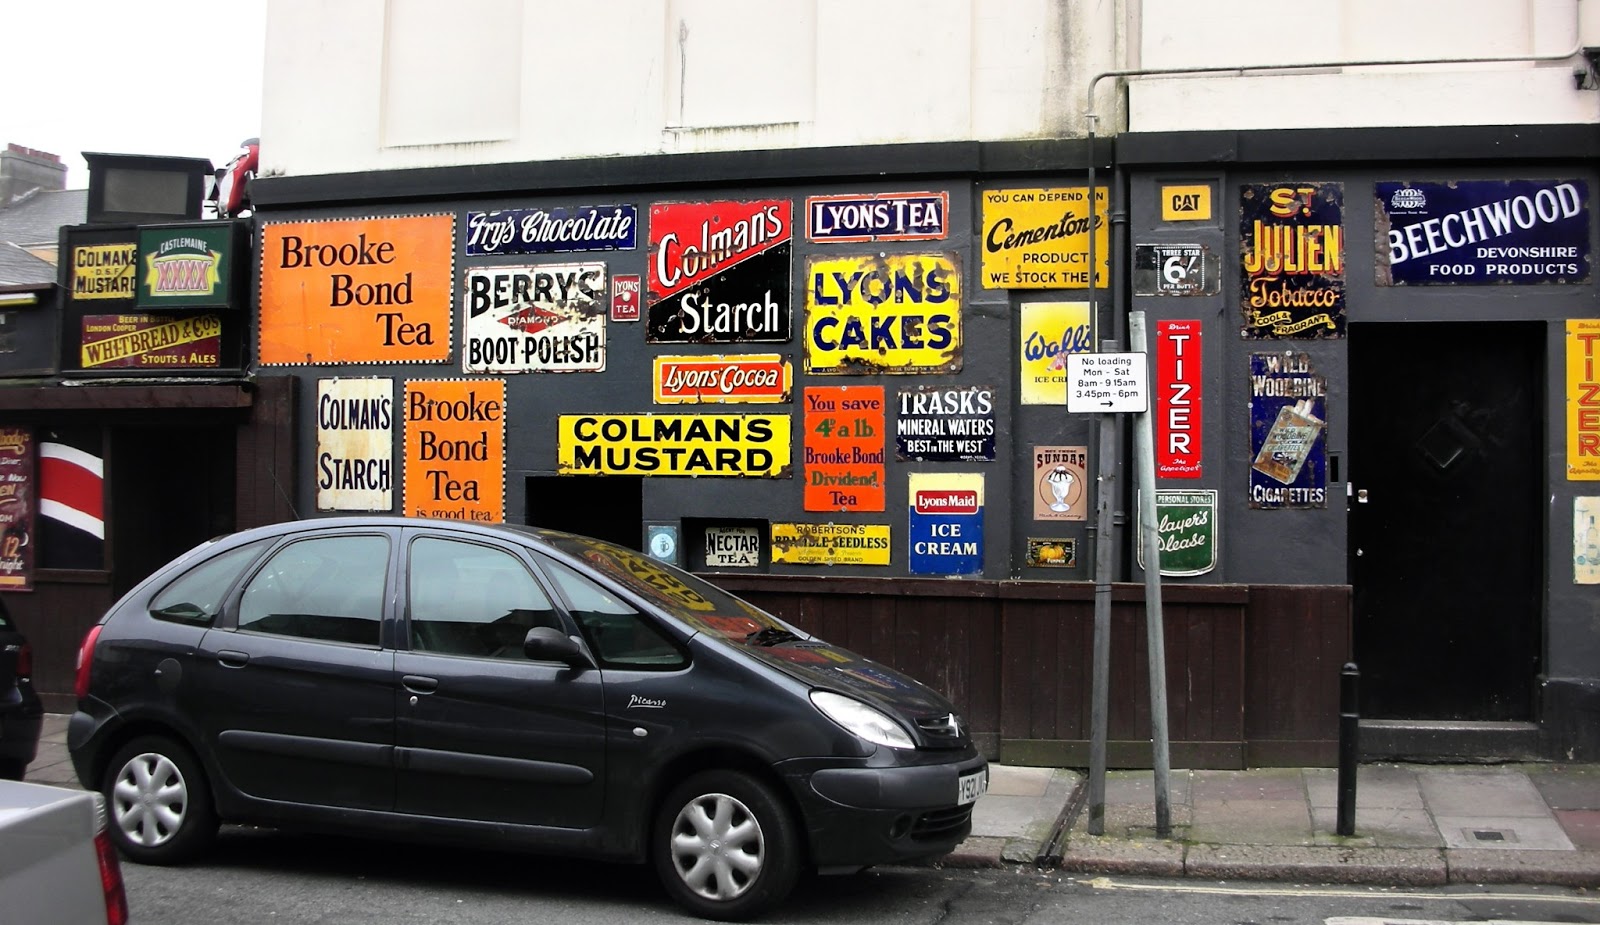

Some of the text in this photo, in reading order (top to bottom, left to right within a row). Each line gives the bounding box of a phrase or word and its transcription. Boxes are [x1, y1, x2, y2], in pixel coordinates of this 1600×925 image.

[988, 194, 1008, 204] YOU
[1012, 194, 1034, 202] CAN
[1038, 192, 1082, 202] DEPEND
[1172, 194, 1200, 212] CAT
[815, 200, 940, 235] LYONS' TEA
[1388, 184, 1580, 264] BEECHWOOD
[468, 208, 632, 252] Fry's Chocolate
[986, 211, 1102, 253] Cementone
[160, 238, 207, 254] CASTLEMAINE
[280, 233, 396, 268] Brooke
[656, 205, 782, 288] Colman's
[1245, 220, 1344, 275] JULIEN
[1476, 247, 1578, 258] DEVONSHIRE
[1023, 252, 1096, 264] PRODUCT
[154, 260, 212, 291] XXXX
[990, 272, 1010, 283] WE
[1016, 272, 1056, 283] STOCK
[1430, 264, 1578, 276] FOOD PRODUCTS
[330, 272, 414, 306] Bond
[1251, 278, 1340, 308] Tobacco
[616, 304, 636, 314] TEA
[679, 289, 778, 334] Starch
[112, 323, 136, 332] COOPER
[376, 312, 434, 346] Tea
[508, 316, 558, 326] DIAMOND
[1256, 314, 1281, 326] COOL
[1276, 316, 1326, 334] FRAGRANT
[813, 314, 952, 352] CAKES
[86, 324, 180, 364] WHITBREAD
[182, 321, 190, 338] &
[470, 336, 598, 364] BOOT POLISH
[142, 354, 178, 364] STOUTS
[190, 352, 216, 364] ALES
[1082, 357, 1132, 366] No loading
[1266, 356, 1308, 374] WILD
[664, 365, 778, 394] Lyons' Cocoa
[1114, 368, 1130, 376] Sat
[1078, 379, 1098, 388] 8am
[807, 394, 880, 412] You save
[898, 390, 992, 415] TRASK'S
[1076, 390, 1110, 398] 3.45pm
[1118, 390, 1139, 398] 6pm
[1169, 334, 1192, 454] TIZER
[1577, 333, 1600, 457] TIZER
[320, 394, 390, 430] COLMAN'S
[409, 390, 500, 422] Brooke
[574, 418, 773, 442] COLMAN'S
[838, 424, 850, 438] a
[854, 418, 876, 438] lb.
[898, 418, 994, 436] MINERAL WATERS
[420, 430, 488, 461] Bond
[937, 440, 955, 453] THE
[574, 446, 773, 472] MUSTARD
[806, 446, 884, 464] Brooke Bond
[1037, 454, 1084, 470] SUNDAE
[320, 452, 390, 490] STARCH
[426, 470, 480, 501] Tea
[1253, 484, 1324, 502] CIGARETTES
[829, 490, 858, 506] Tea
[918, 495, 976, 510] Lyons Maid
[1157, 496, 1212, 504] PERSONAL STORES
[416, 506, 426, 518] is
[432, 507, 464, 520] good
[1157, 510, 1208, 534] layer's
[796, 526, 866, 534] ROBERTSON'S
[931, 524, 962, 537] ICE
[4, 536, 20, 558] 12
[708, 532, 758, 555] NECTAR
[832, 536, 888, 548] SEEDLESS
[914, 542, 978, 556] CREAM
[718, 554, 750, 564] TEA
[627, 694, 666, 708] Picasso
